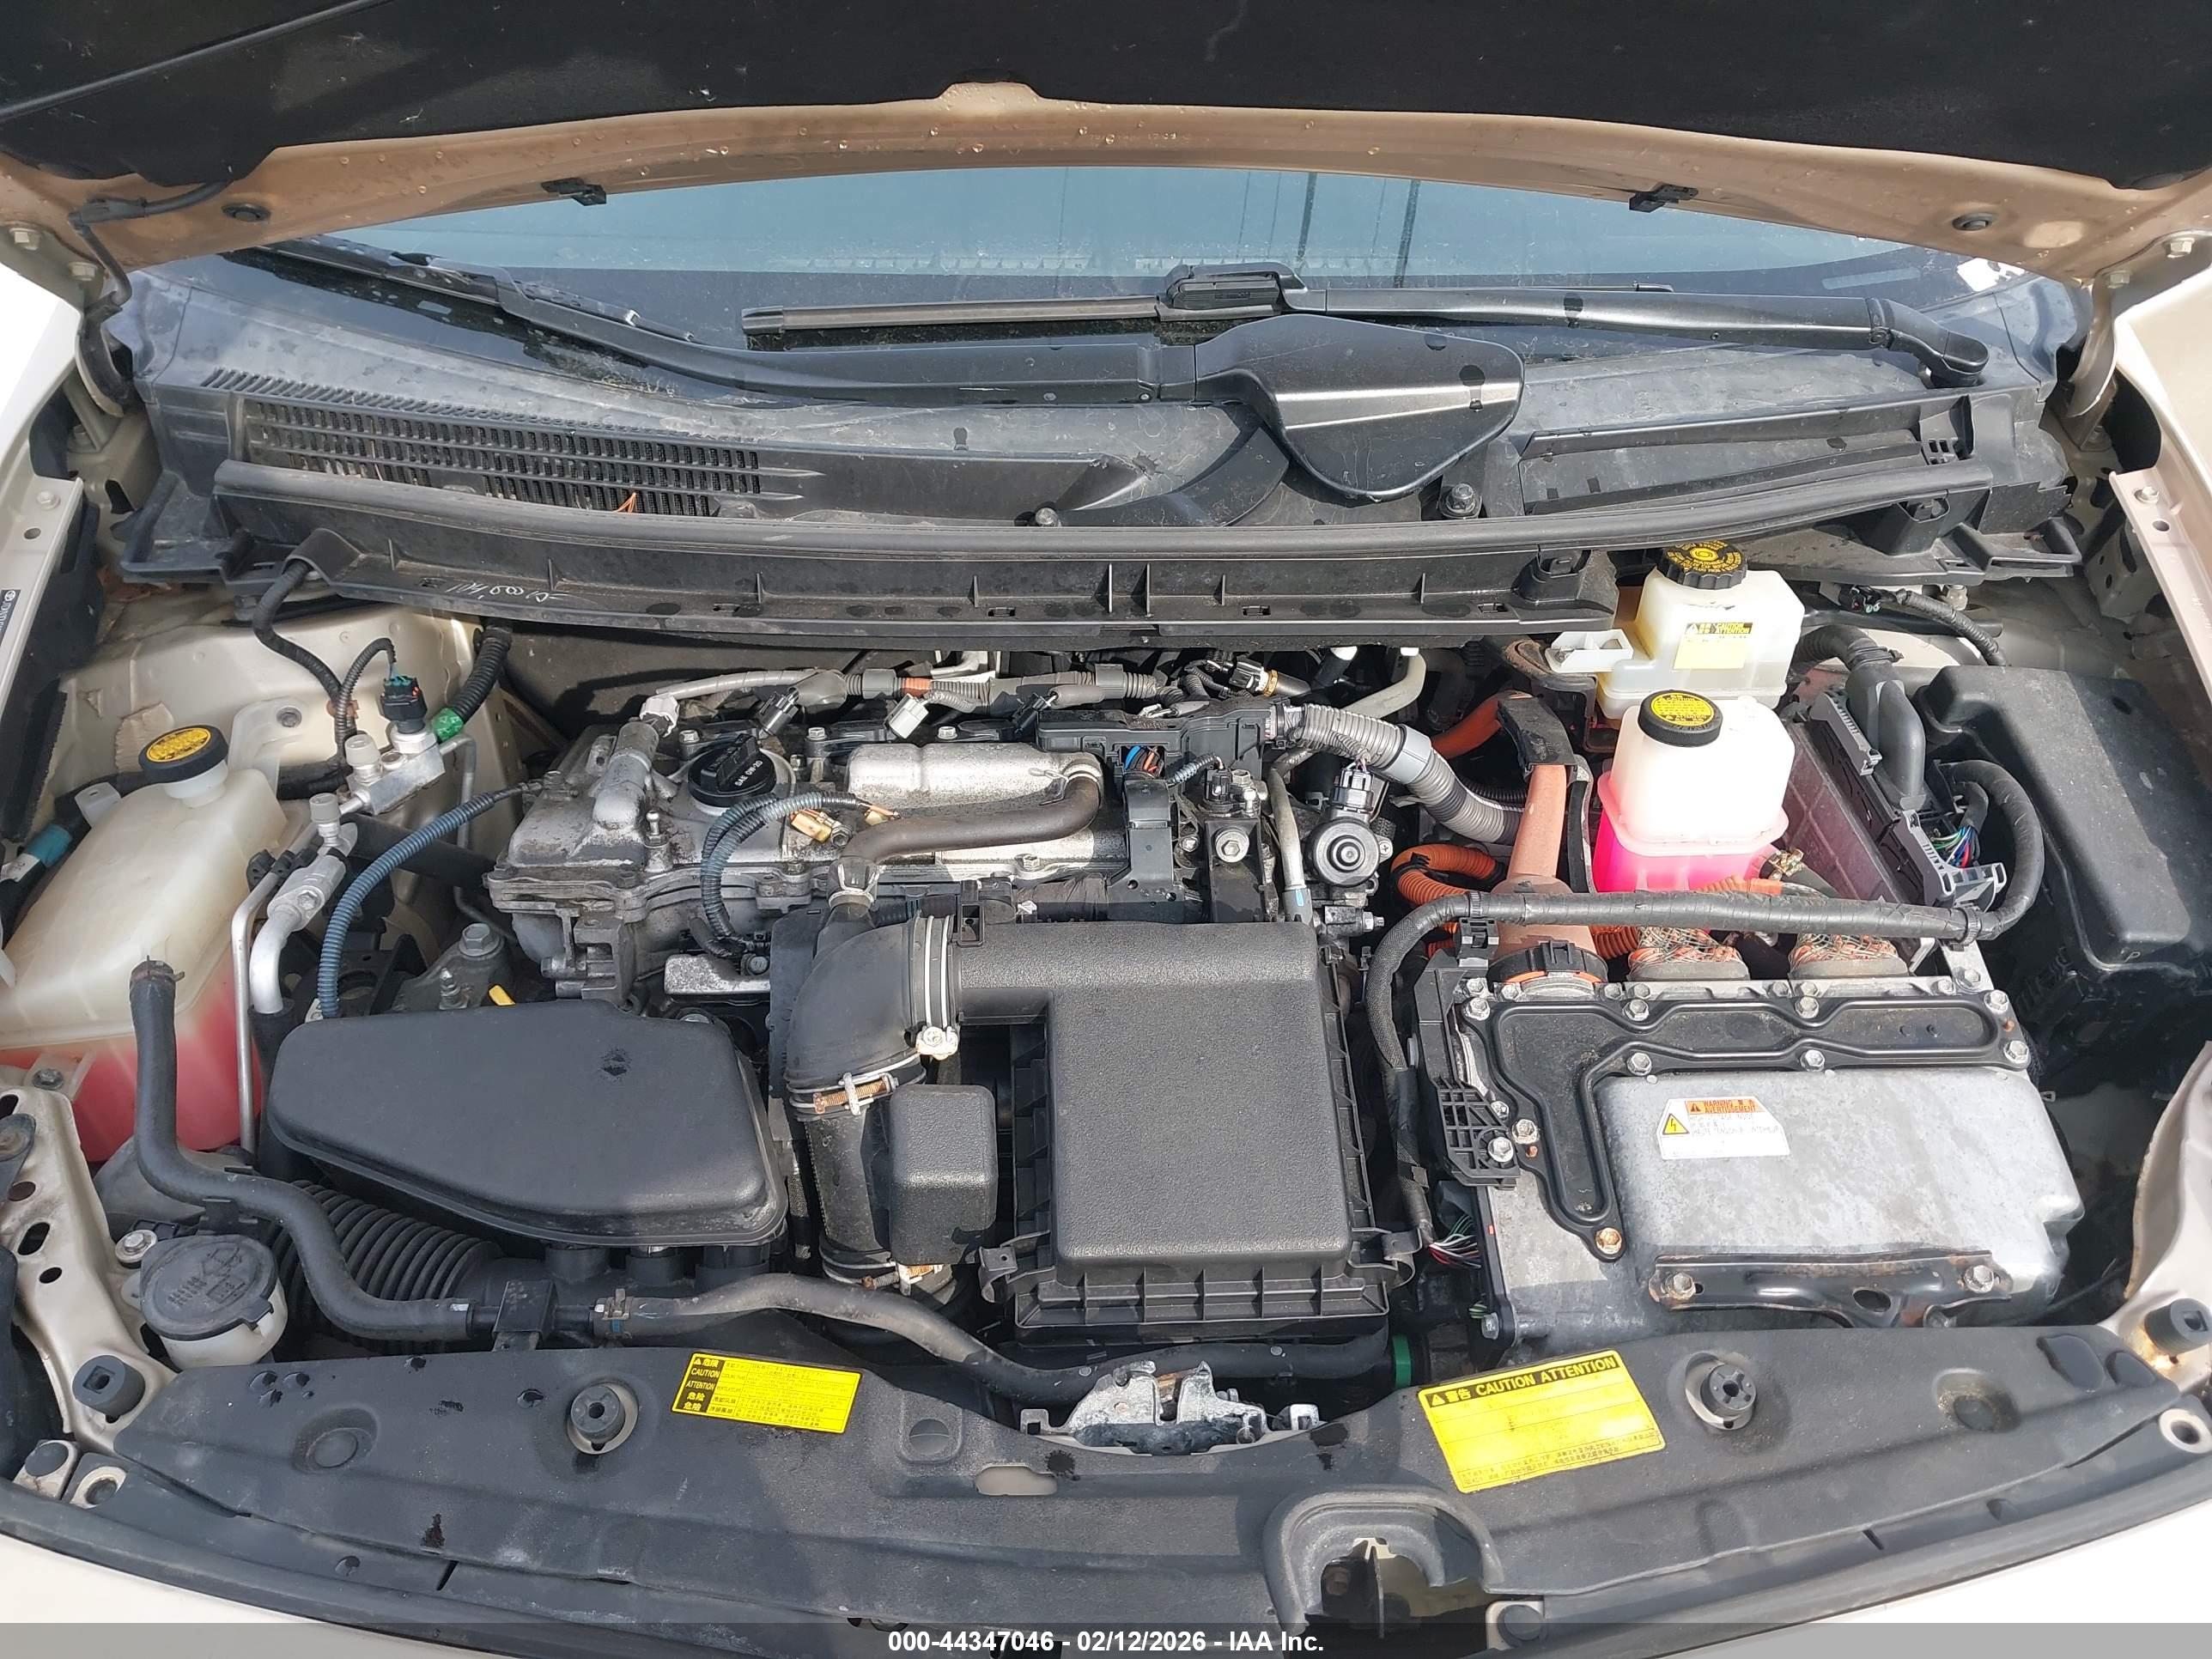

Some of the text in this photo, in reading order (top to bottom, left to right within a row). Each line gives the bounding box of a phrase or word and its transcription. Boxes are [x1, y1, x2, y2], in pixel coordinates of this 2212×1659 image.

[691, 1368, 720, 1378] CAUTION
[1476, 1374, 1535, 1396] CAUTION
[1540, 1357, 1617, 1383] ATTENTION
[686, 1381, 715, 1390] ATTENTION
